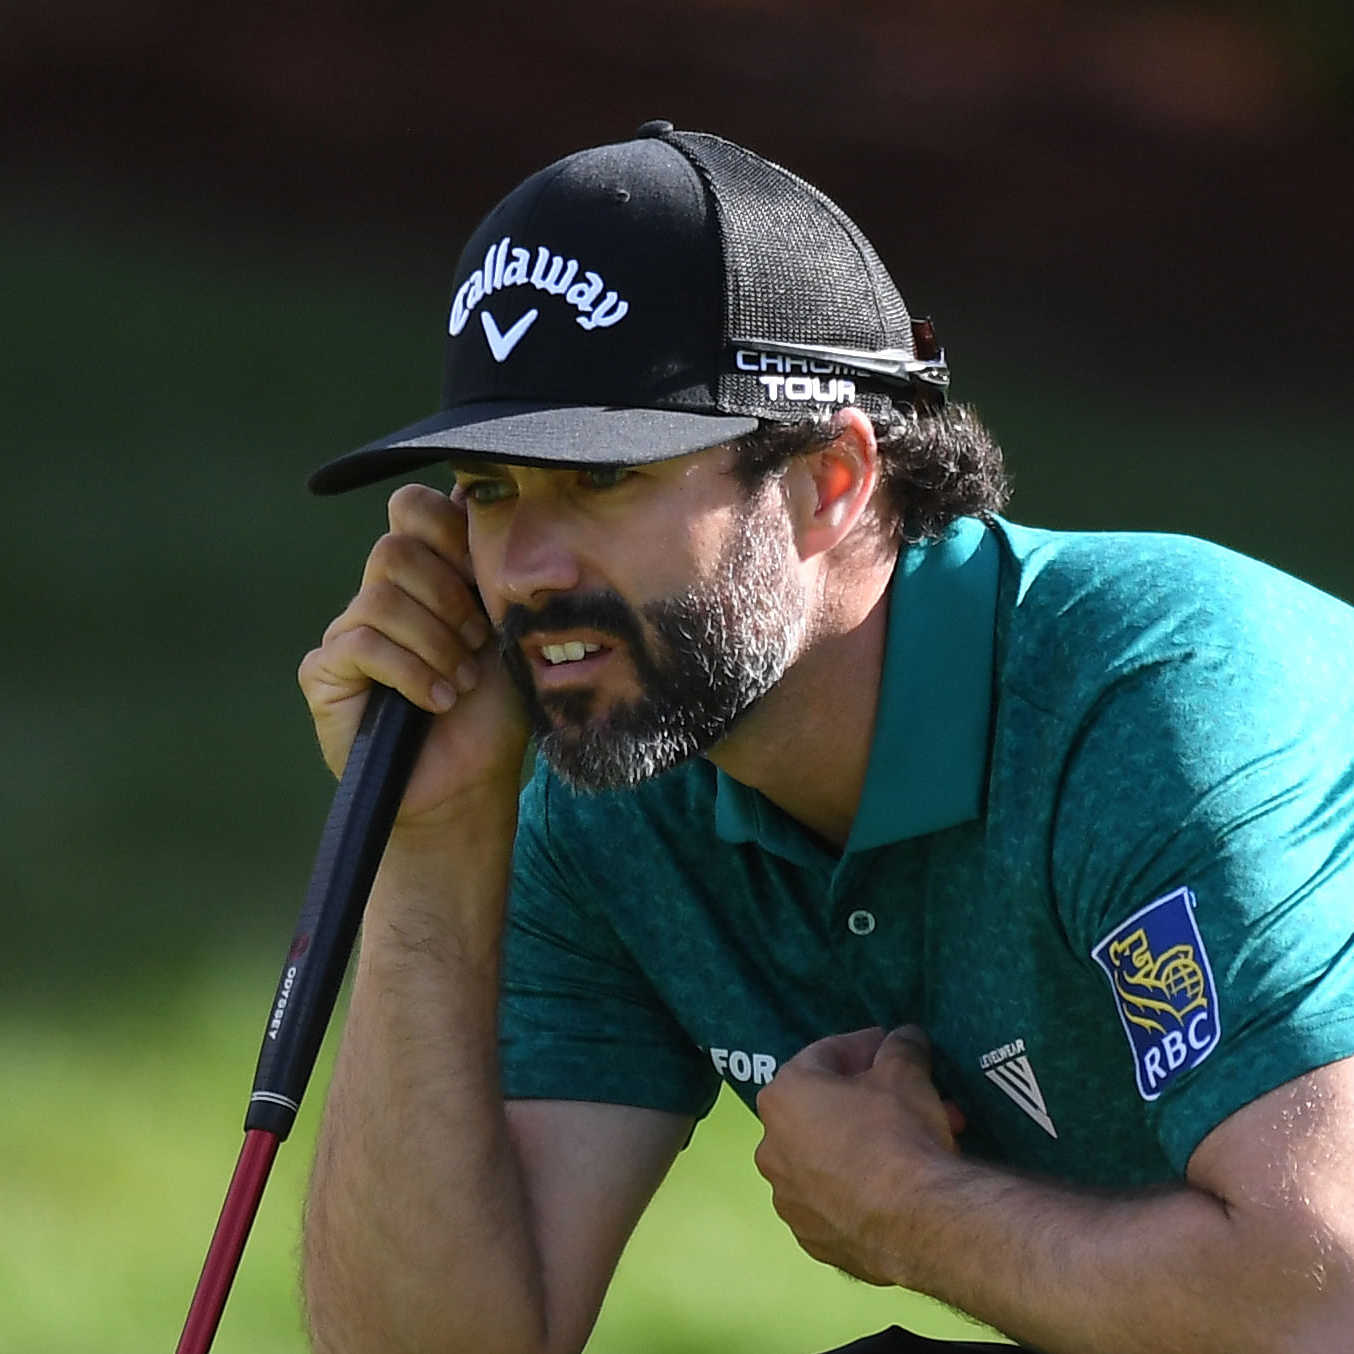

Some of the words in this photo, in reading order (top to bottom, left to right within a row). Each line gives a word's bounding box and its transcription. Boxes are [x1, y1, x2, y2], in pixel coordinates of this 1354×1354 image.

[449, 237, 628, 337] Callaway
[759, 375, 856, 404] TOUR
[268, 966, 297, 1040] ODYSSEY
[710, 1047, 777, 1085] FOR
[979, 1038, 1026, 1069] LEVELWEAR
[1144, 1012, 1211, 1089] RBC
